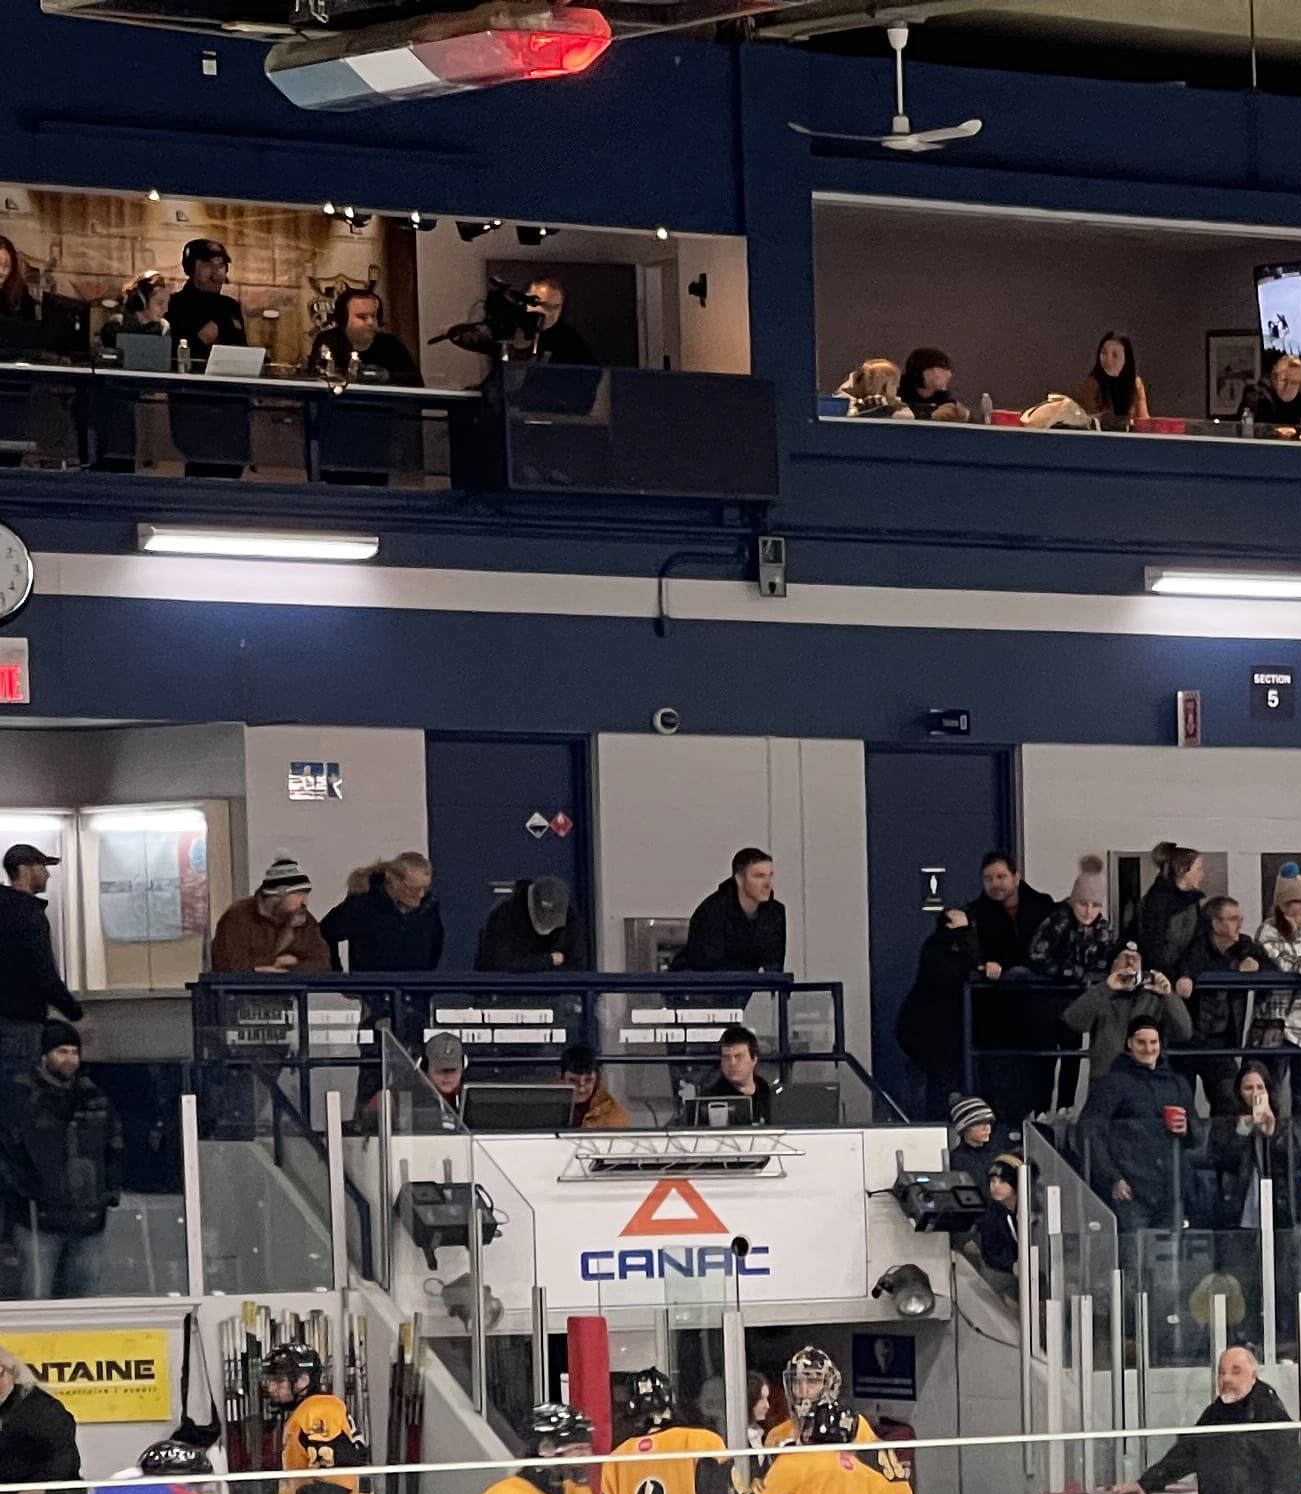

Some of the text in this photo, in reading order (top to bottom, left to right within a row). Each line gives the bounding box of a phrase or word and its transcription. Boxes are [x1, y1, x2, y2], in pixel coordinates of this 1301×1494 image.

[1253, 673, 1292, 684] SECTION
[1267, 689, 1280, 708] 5
[580, 1246, 771, 1282] CANAC
[25, 1358, 156, 1383] NTAINE
